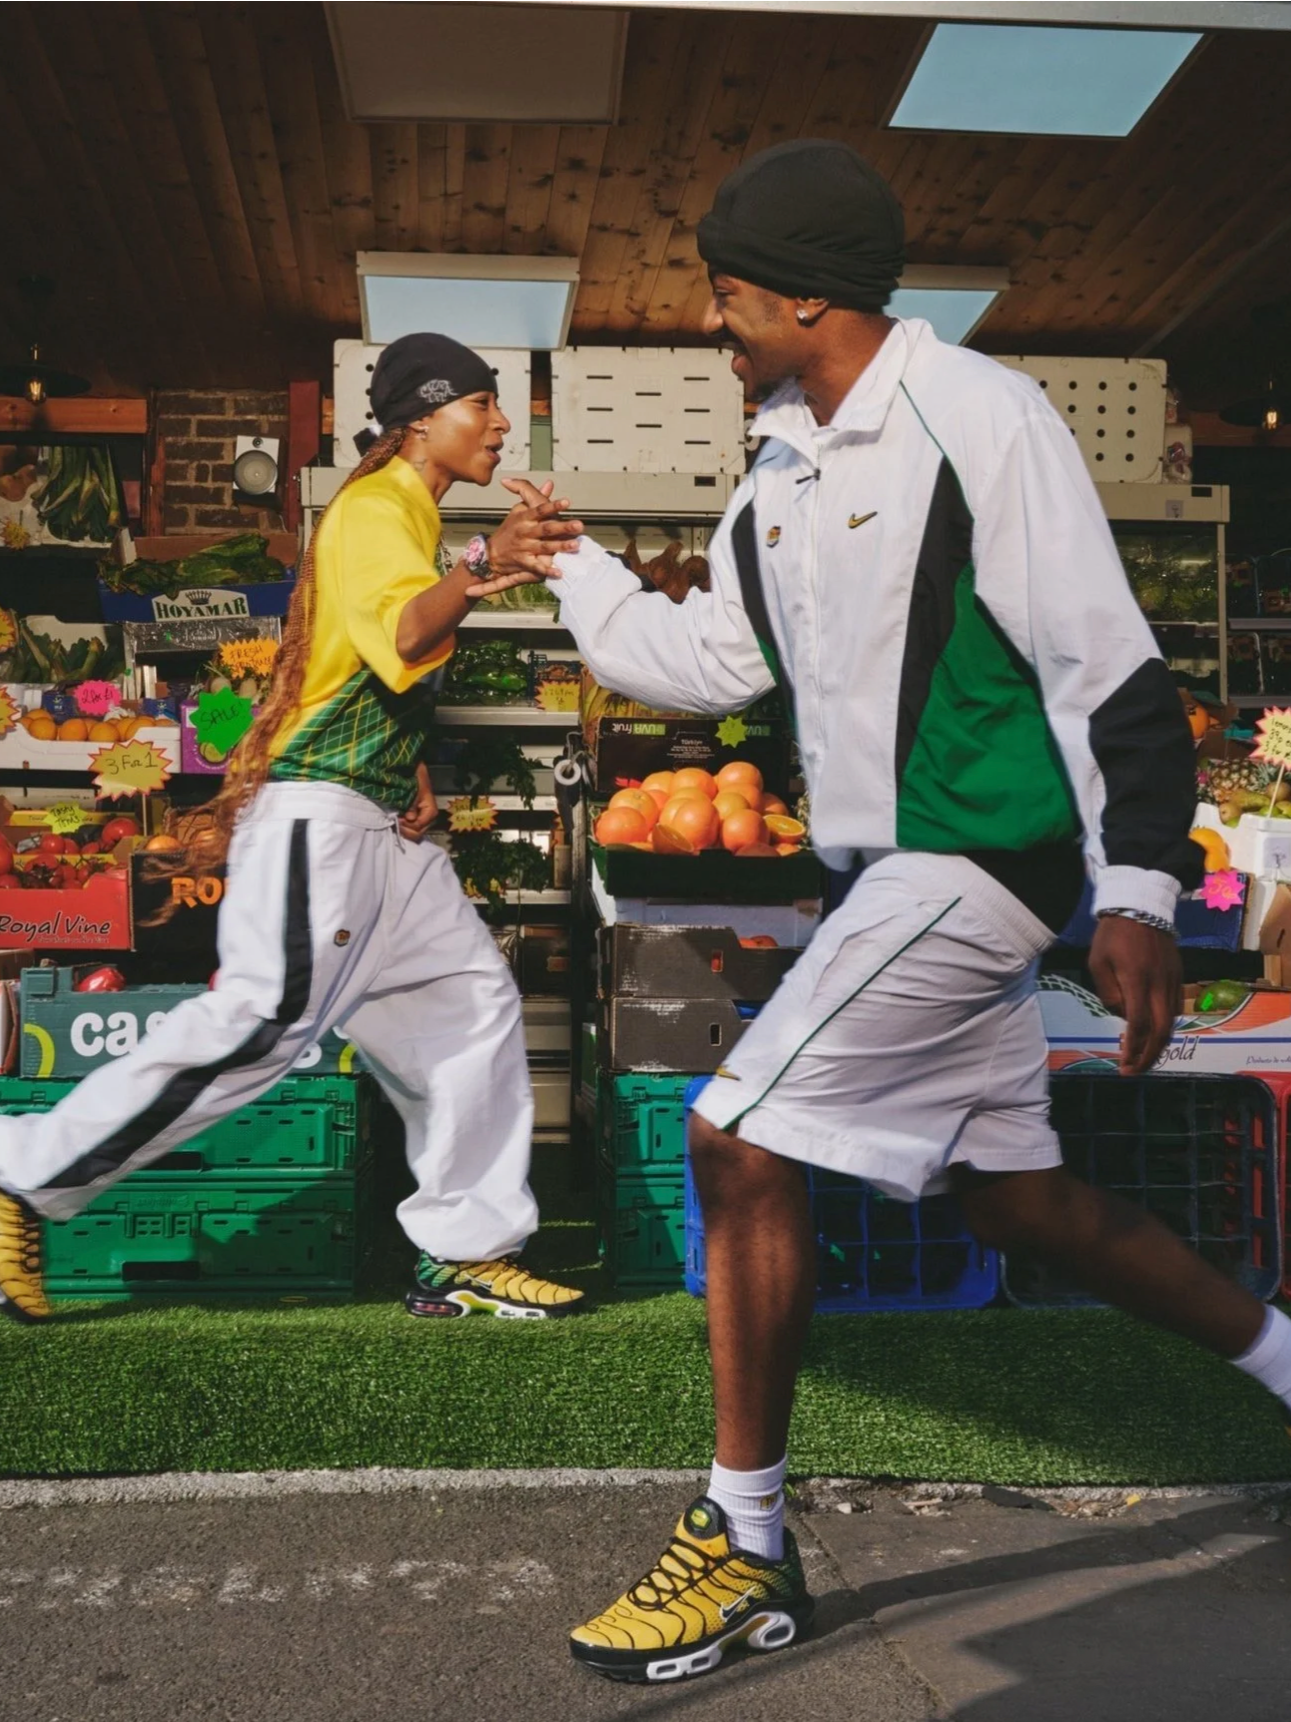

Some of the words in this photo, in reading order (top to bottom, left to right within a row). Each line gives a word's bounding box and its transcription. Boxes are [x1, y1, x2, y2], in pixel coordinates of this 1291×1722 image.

[154, 596, 248, 619] HOYAMAR
[612, 722, 632, 734] fruit
[633, 723, 657, 735] UVA
[105, 757, 120, 776] 3
[143, 751, 159, 769] 1
[171, 876, 231, 909] RO
[0, 910, 62, 943] Royal
[64, 915, 111, 935] Vine
